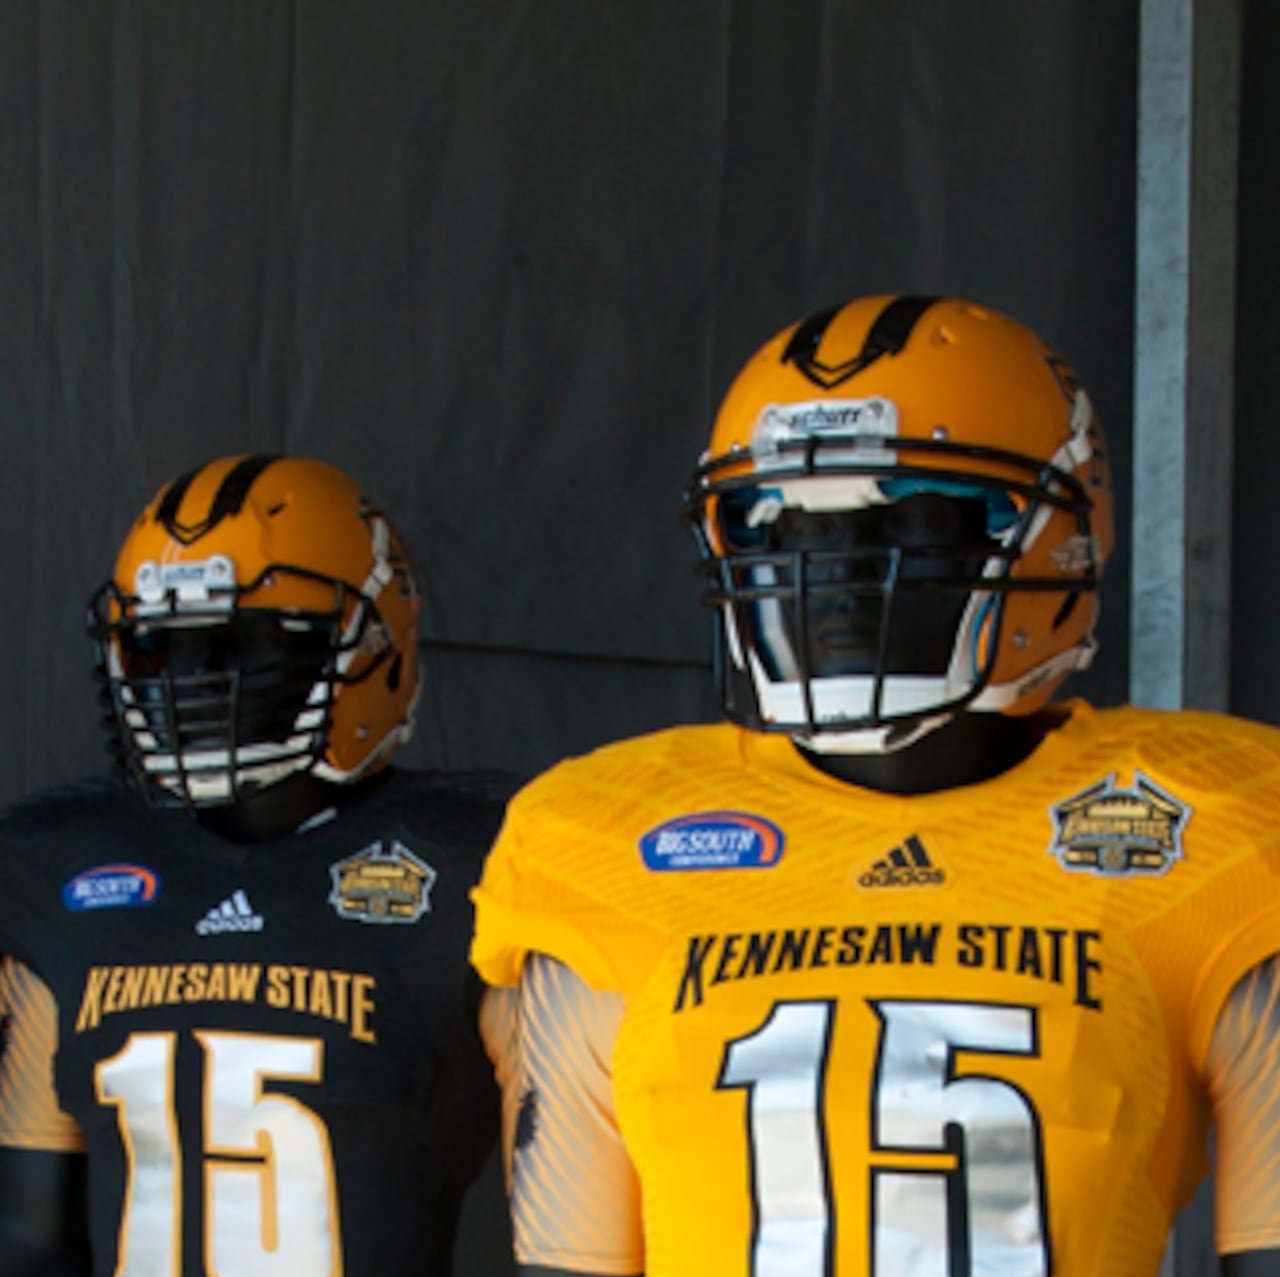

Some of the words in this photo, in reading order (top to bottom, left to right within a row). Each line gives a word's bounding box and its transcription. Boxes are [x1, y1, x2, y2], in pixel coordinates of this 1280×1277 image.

[656, 831, 689, 855] BIG
[689, 828, 755, 852] SOUTH
[857, 866, 946, 889] adidas
[673, 924, 941, 1012] KENNESAW
[957, 924, 1103, 1012] STATE
[74, 962, 263, 1034] KENNESAW
[266, 965, 378, 1045] STATE
